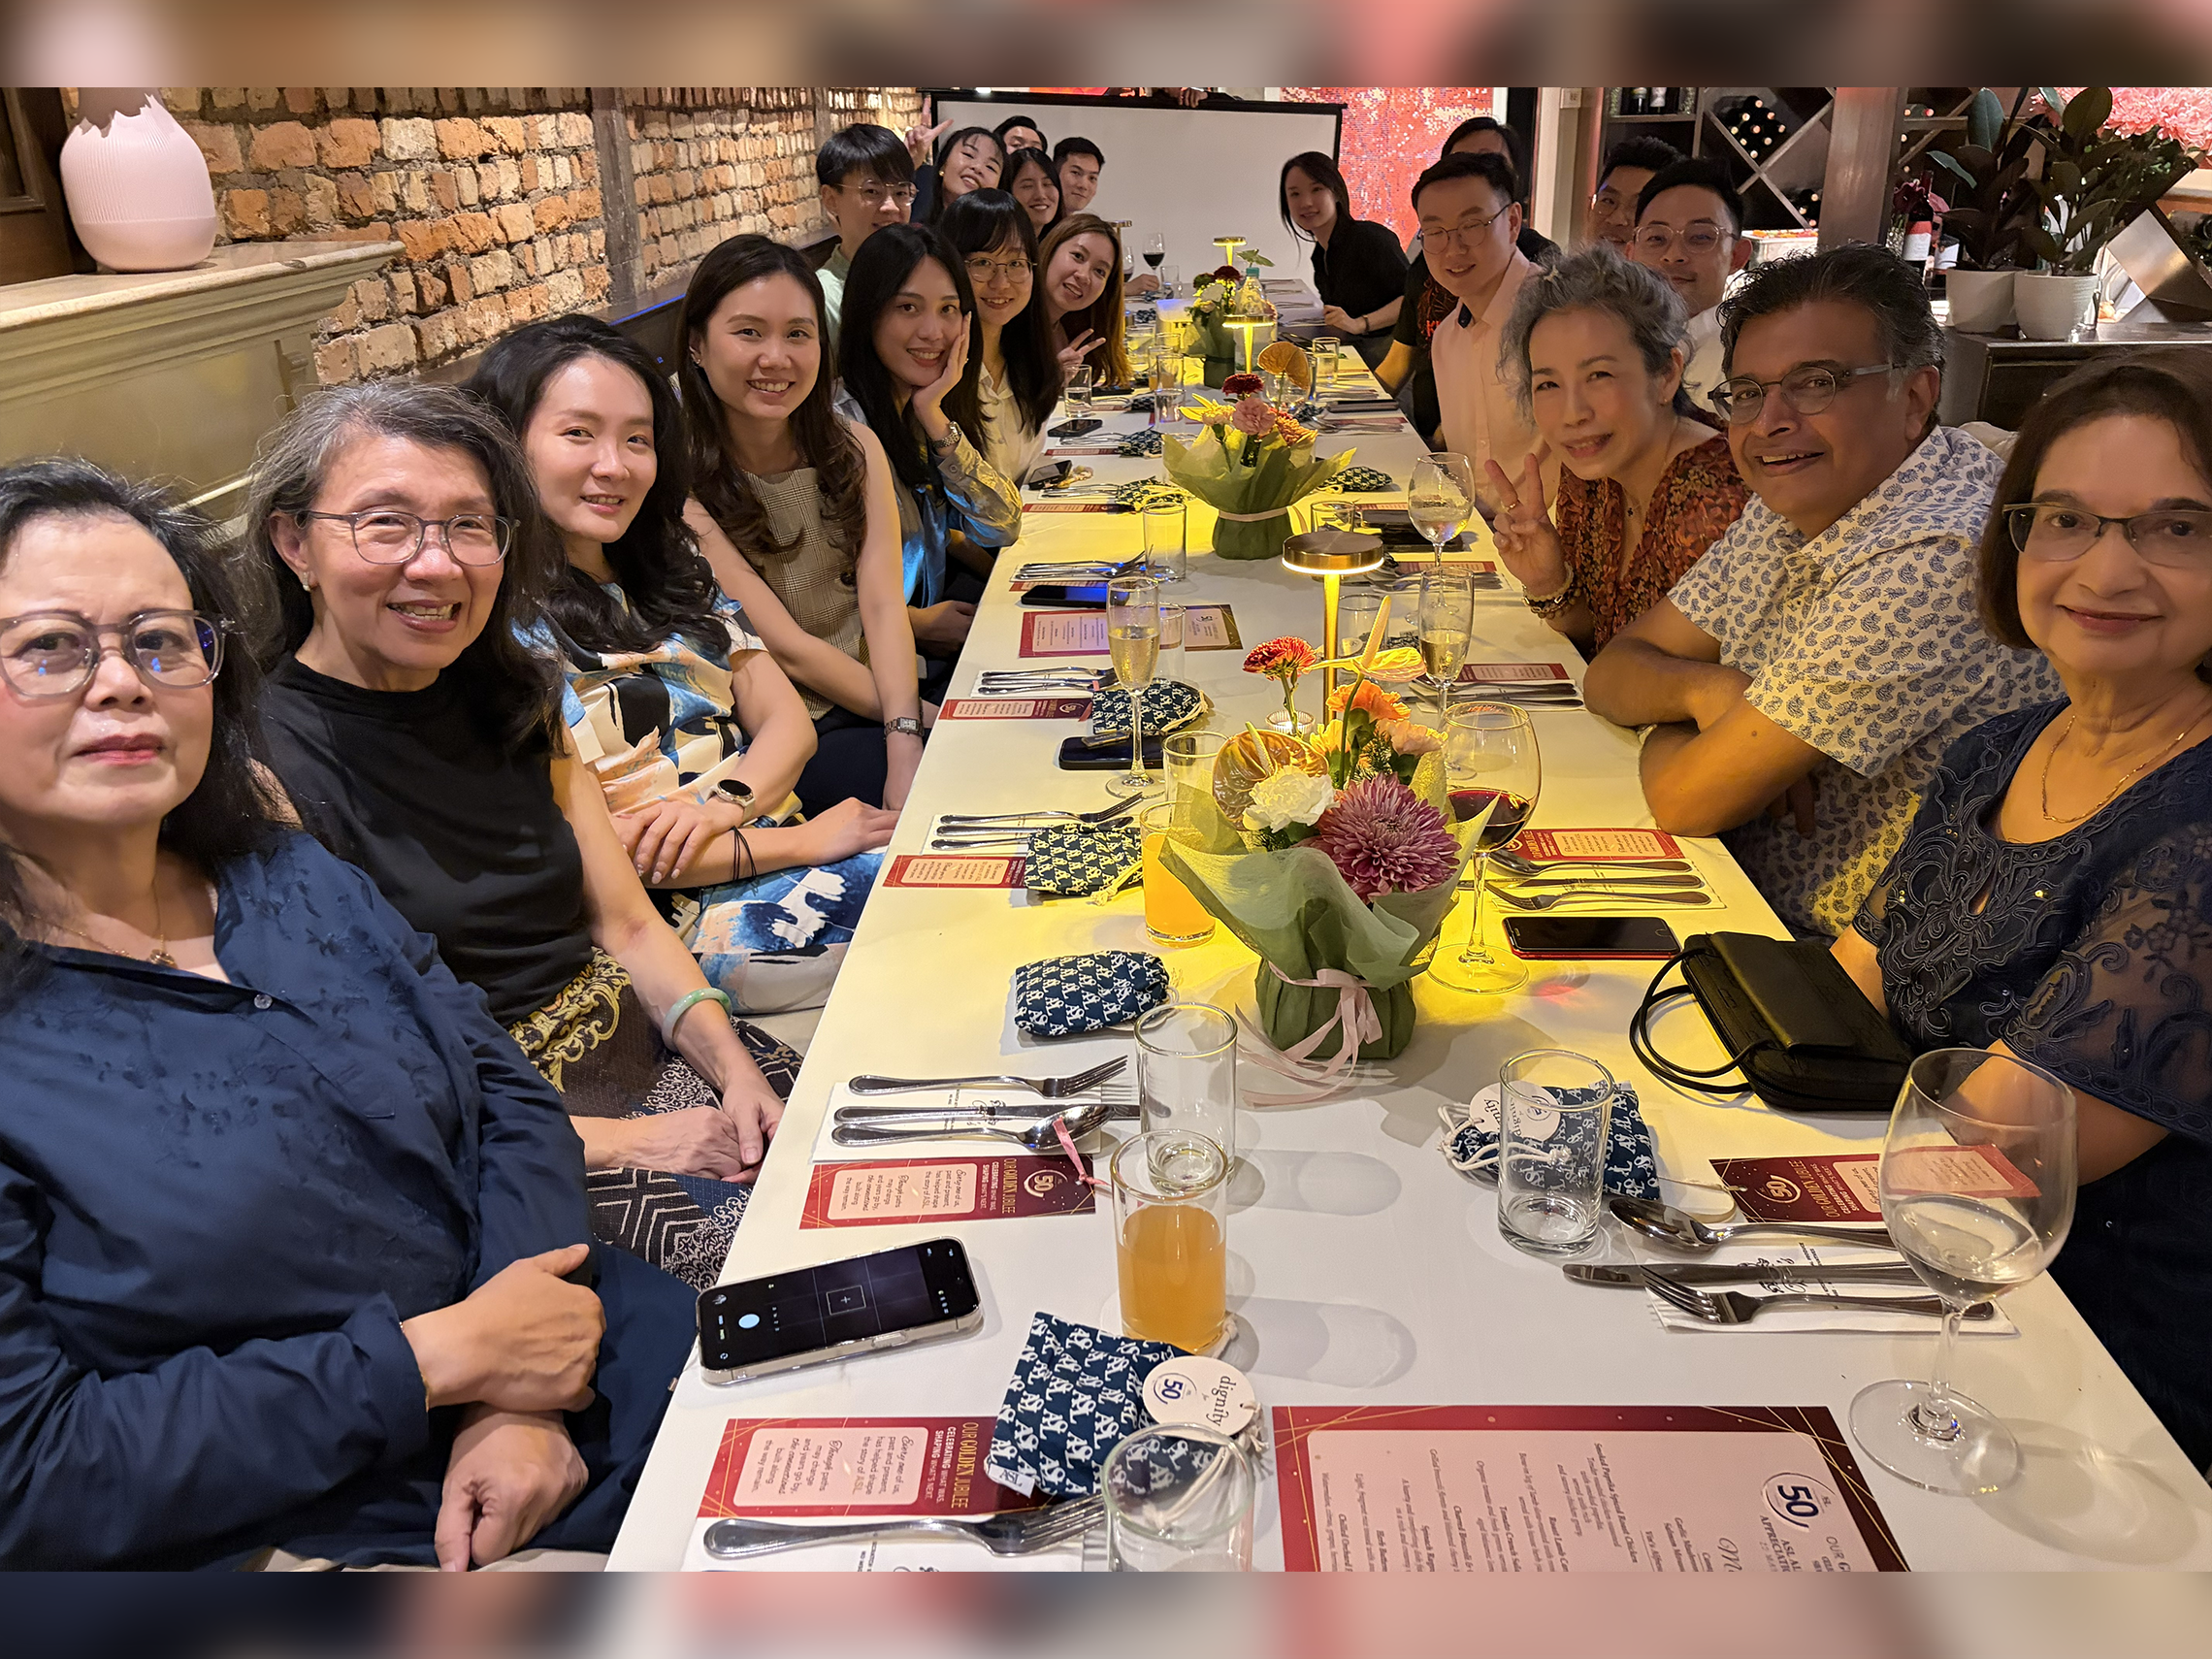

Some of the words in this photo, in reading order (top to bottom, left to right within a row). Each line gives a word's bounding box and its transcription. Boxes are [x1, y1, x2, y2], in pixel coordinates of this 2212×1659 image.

[991, 1161, 999, 1189] CELEBRATING
[1002, 1169, 1018, 1193] GOLDEN
[1033, 1175, 1055, 1192] 50
[1766, 1181, 1793, 1198] 50
[1041, 1329, 1064, 1356] ASL
[1065, 1327, 1093, 1350] ASL
[1027, 1359, 1053, 1385] ASL
[1055, 1353, 1082, 1373] ASL
[1105, 1354, 1129, 1382] ASL
[1046, 1376, 1074, 1401] ASL
[1076, 1372, 1104, 1388] ASL
[1161, 1378, 1184, 1400] 50
[1017, 1390, 1045, 1414] ASL
[1069, 1389, 1096, 1424] ASL
[1098, 1386, 1125, 1404] ASL
[1206, 1376, 1237, 1427] dignity
[961, 1421, 979, 1439] OUR
[1039, 1408, 1068, 1440] ASL
[1093, 1411, 1120, 1449] ASL
[764, 1440, 774, 1451] the
[812, 1445, 823, 1459] may
[862, 1436, 871, 1448] the
[875, 1436, 885, 1448] has
[888, 1436, 896, 1451] past
[896, 1435, 914, 1461] Every
[931, 1430, 945, 1459] SHAPING
[942, 1426, 957, 1469] CELEBRATING
[991, 1437, 1018, 1464] ASL
[1064, 1431, 1093, 1469] ASL
[758, 1451, 768, 1466] way
[773, 1448, 785, 1463] built
[797, 1451, 808, 1471] years
[823, 1440, 843, 1471] Though
[857, 1448, 867, 1465] story
[870, 1448, 882, 1473] helped
[886, 1451, 895, 1465] and
[957, 1439, 978, 1476] GOLDEN
[765, 1464, 779, 1484] along
[778, 1450, 795, 1495] connections
[794, 1472, 802, 1481] go
[806, 1460, 819, 1486] change
[819, 1472, 830, 1492] paths
[865, 1473, 876, 1495] shape
[939, 1469, 949, 1487] WHAT
[999, 1469, 1023, 1487] ASL
[951, 1477, 971, 1509] JUBILEE
[1594, 1443, 1609, 1466] Smoked
[1603, 1466, 1615, 1492] Paprika
[1617, 1514, 1630, 1535] Roast
[1625, 1535, 1638, 1564] Chicken
[1777, 1484, 1819, 1517] 50
[1338, 1513, 1350, 1538] Chilled
[1499, 1506, 1511, 1531] Tomato
[1506, 1532, 1518, 1556] Crunch
[1549, 1516, 1560, 1537] Roast
[1377, 1529, 1386, 1546] Herb
[1554, 1537, 1567, 1557] Lamb
[1781, 1539, 1796, 1556] ASL
[1826, 1536, 1845, 1560] OUR
[1342, 1538, 1353, 1567] Orchard
